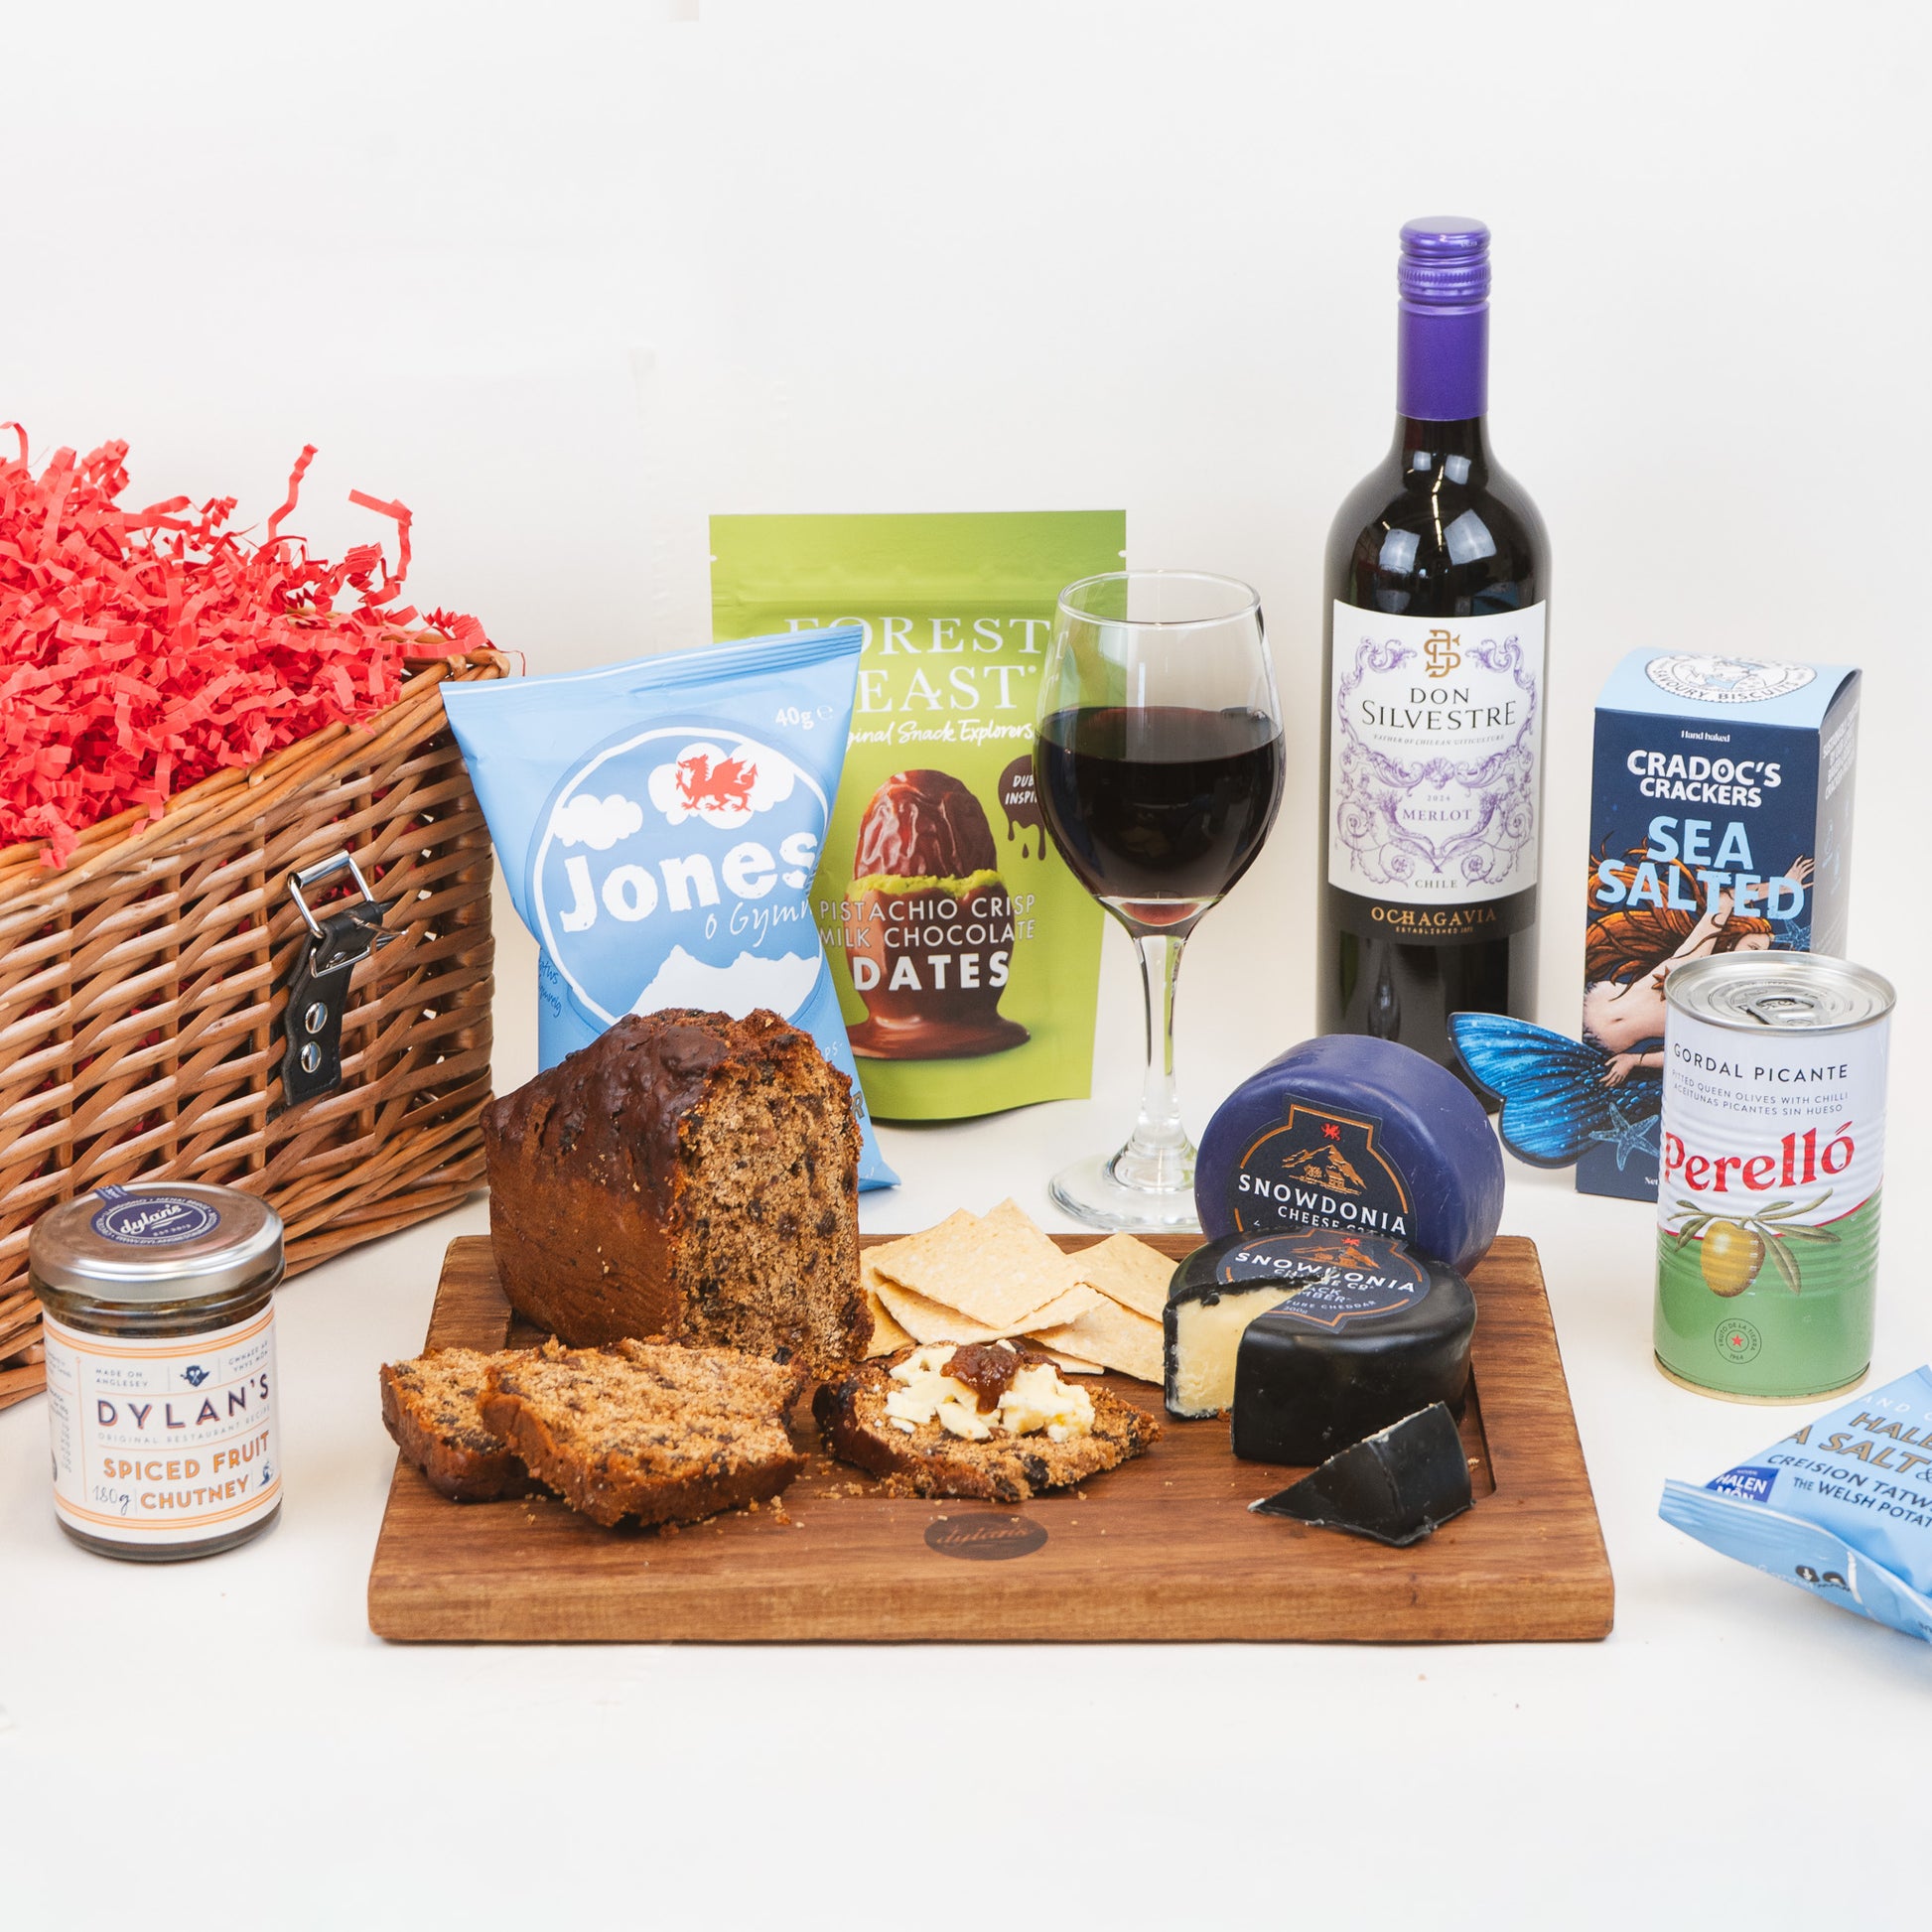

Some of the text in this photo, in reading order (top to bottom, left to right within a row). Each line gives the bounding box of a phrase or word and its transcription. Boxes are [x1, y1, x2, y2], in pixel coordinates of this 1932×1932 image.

[857, 666, 1026, 713] EAST
[1410, 687, 1469, 705] DON
[1719, 681, 1799, 700] BISCUITS
[774, 706, 815, 731] 40g
[1362, 699, 1516, 731] SILVESTRE
[897, 721, 956, 745] Snack
[957, 718, 1035, 747] Explorers
[1681, 730, 1730, 743] Hand baked
[1626, 749, 1782, 788] CRADOC'S
[1005, 790, 1037, 805] INSPI
[1639, 776, 1762, 808] CRACKERS
[1402, 808, 1473, 821] MERLOT
[1646, 815, 1754, 871] SEA
[559, 832, 818, 933] Jones
[1415, 880, 1458, 889] CHILE
[1595, 858, 1805, 920] SALTED
[820, 894, 1035, 922] PISTACHIO CRISP
[1371, 905, 1497, 927] OCHAGAVIA
[819, 918, 1035, 948] MILK CHOCOLATE
[852, 950, 1010, 992] DATES
[1673, 1042, 1848, 1082] GORDAL PICANTE
[1672, 1069, 1849, 1105] PITTED QUEEN OLIVES WITH CHILLI
[1673, 1083, 1843, 1116] ACEITUNAS PICANTES SIN HUESO
[1664, 1120, 1856, 1192] Perelló
[1238, 1173, 1407, 1236] SNOWDONIA
[95, 1369, 122, 1378] MADE
[96, 1373, 269, 1430] DYLAN'S
[97, 1432, 159, 1444] ORIGINAL
[167, 1421, 240, 1444] RESTAURANT
[103, 1430, 269, 1480] SPICED FRUIT
[1818, 1433, 1932, 1473] SALT
[140, 1474, 249, 1510] CHUTNEY
[1767, 1453, 1932, 1511] CREISION TATW
[1793, 1476, 1815, 1491] THE
[1818, 1480, 1876, 1509] WELSH
[93, 1485, 131, 1516] 180g
